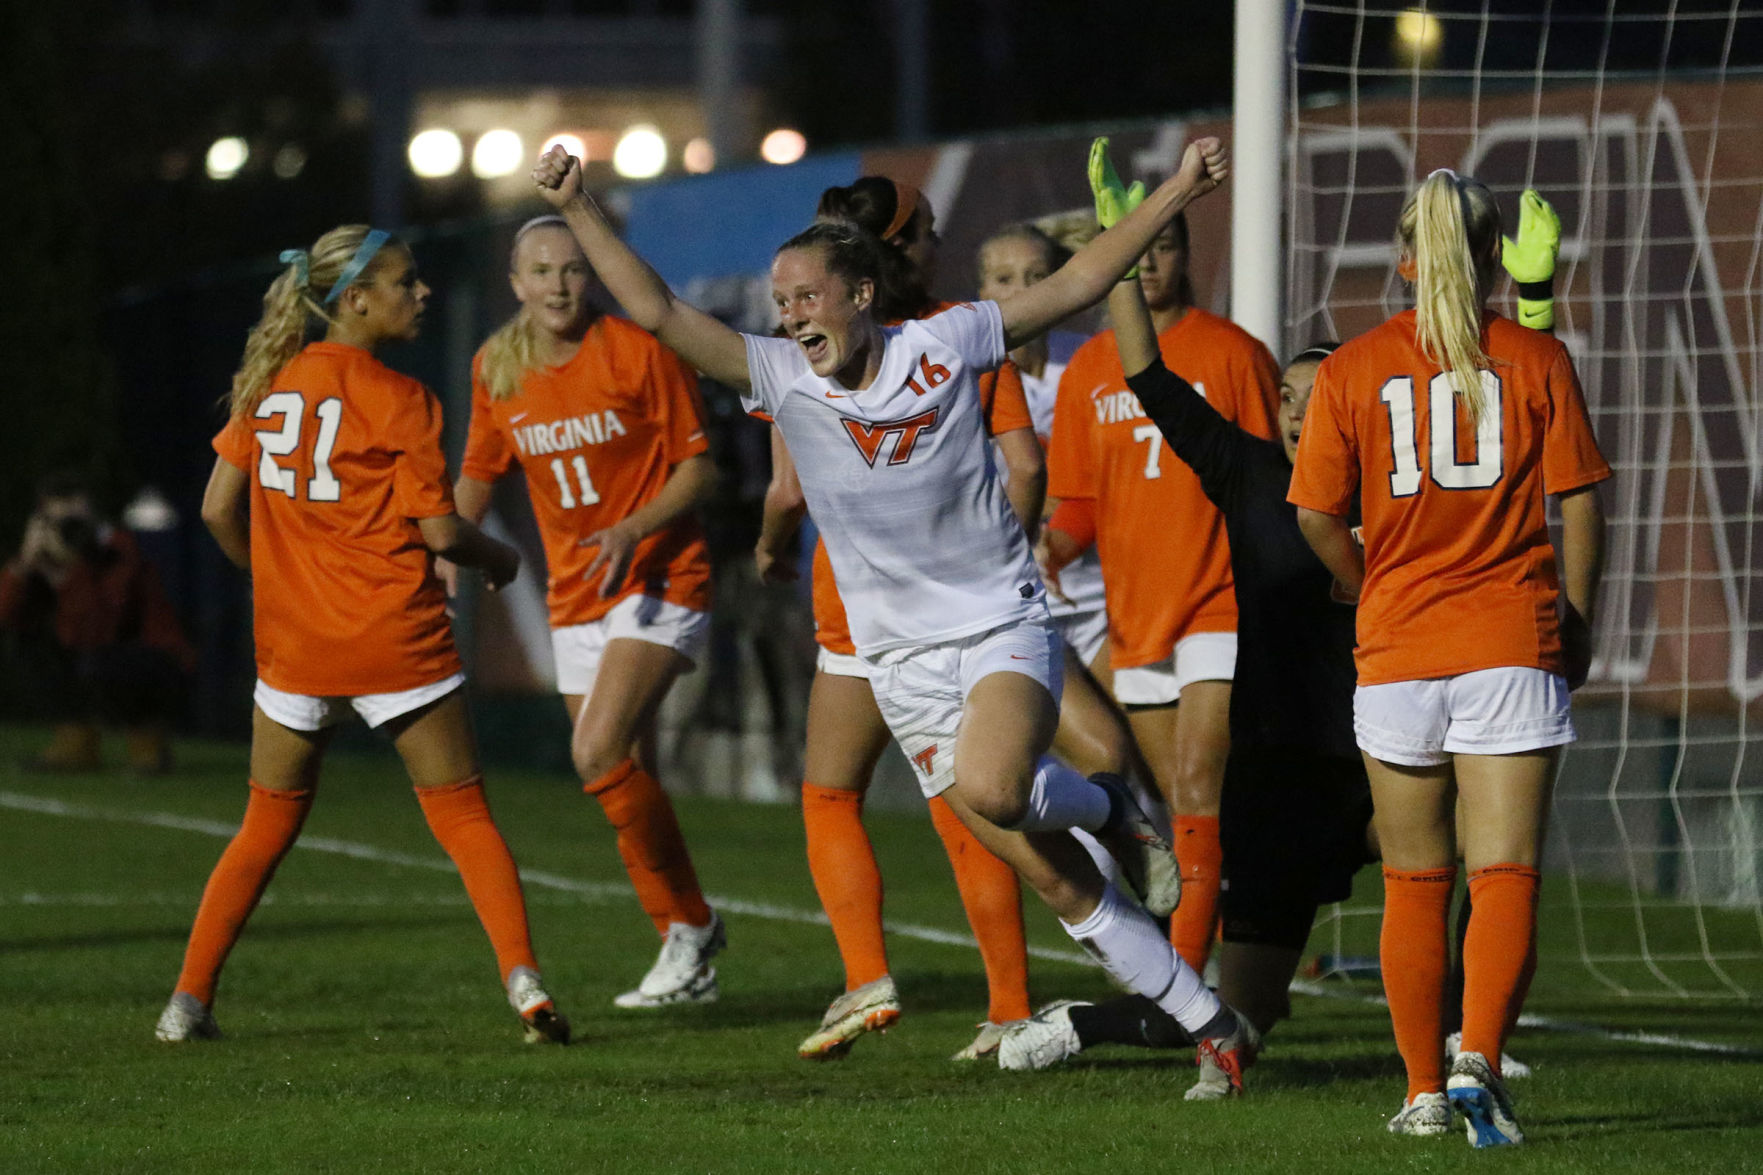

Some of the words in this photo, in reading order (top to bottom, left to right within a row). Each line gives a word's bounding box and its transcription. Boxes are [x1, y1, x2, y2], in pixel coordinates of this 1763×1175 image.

[905, 352, 951, 397] 16
[254, 391, 342, 502] 21
[513, 410, 626, 455] VIRGINIA
[839, 405, 939, 469] VT
[1133, 424, 1163, 479] 7
[1379, 368, 1503, 498] 10
[550, 455, 600, 509] 11
